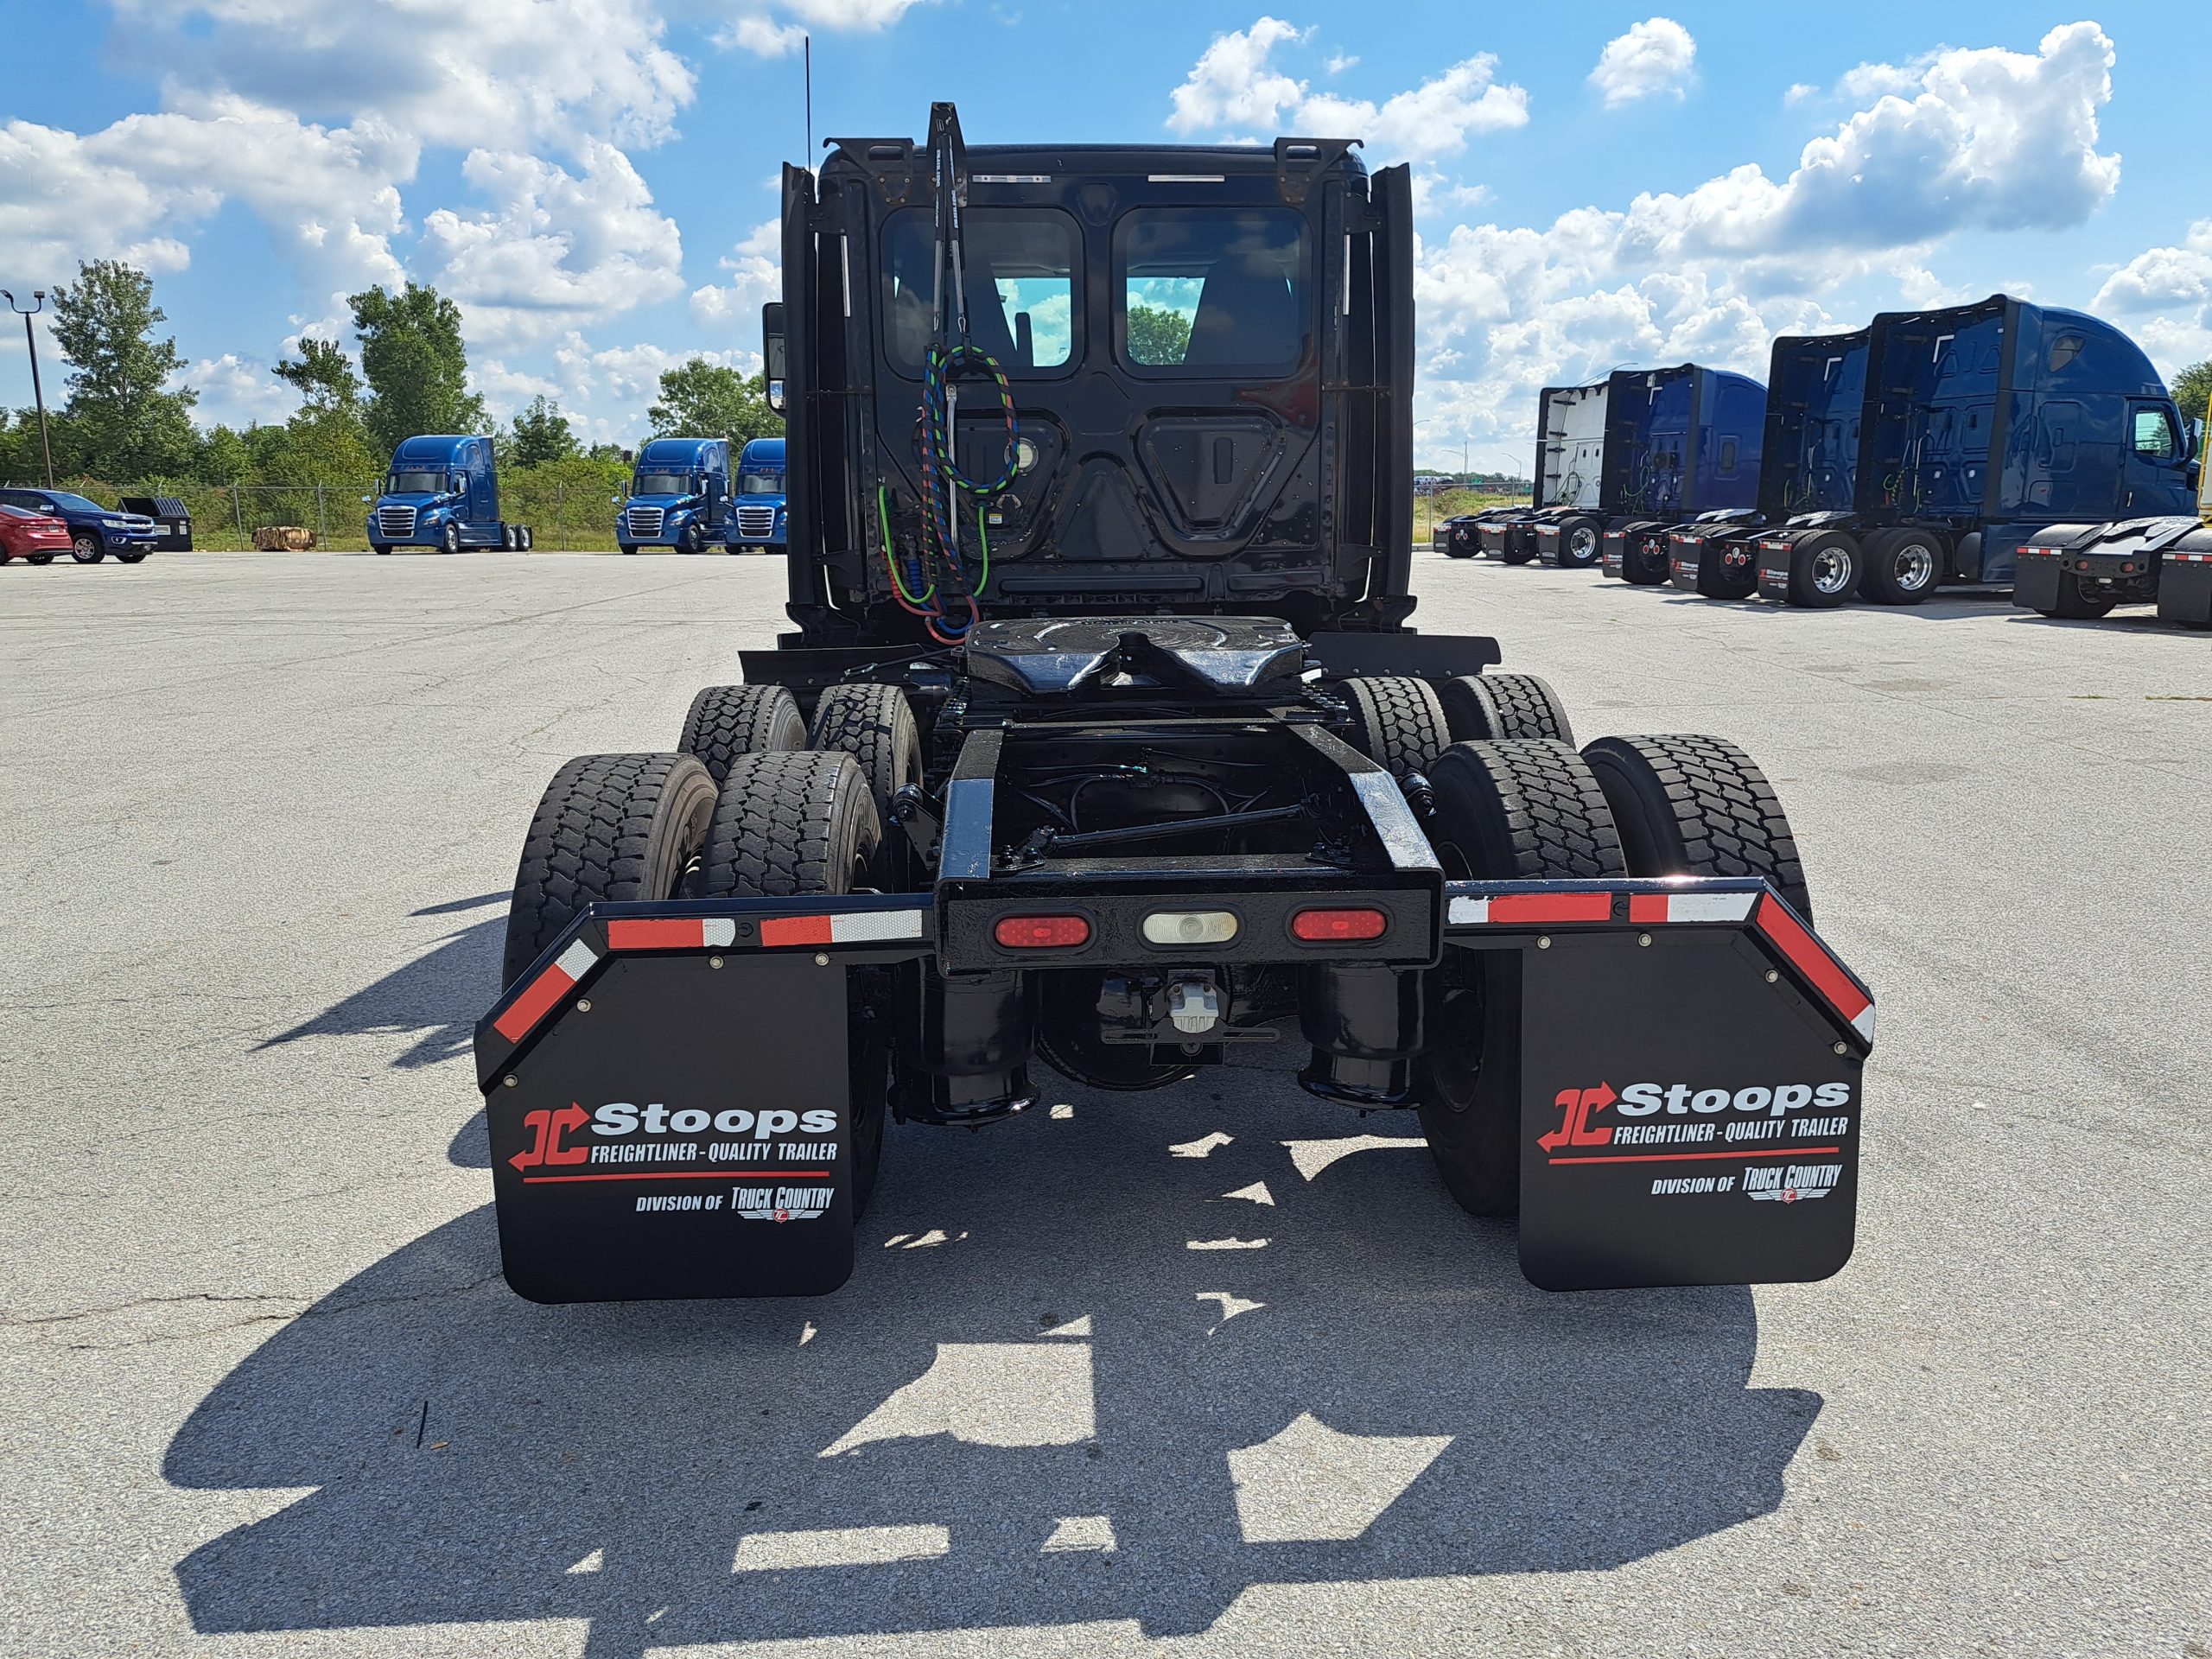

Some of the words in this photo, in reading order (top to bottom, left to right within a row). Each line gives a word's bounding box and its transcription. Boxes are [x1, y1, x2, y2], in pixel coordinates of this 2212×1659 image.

[1617, 1082, 1851, 1116] Stoops
[591, 1103, 837, 1139] Stoops
[1790, 1116, 1849, 1138] TRAILER
[778, 1142, 837, 1160] TRAILER
[1650, 1177, 1716, 1195] DIVISION
[1717, 1176, 1736, 1192] OF
[636, 1195, 702, 1212] DIVISION
[704, 1194, 724, 1211] OF
